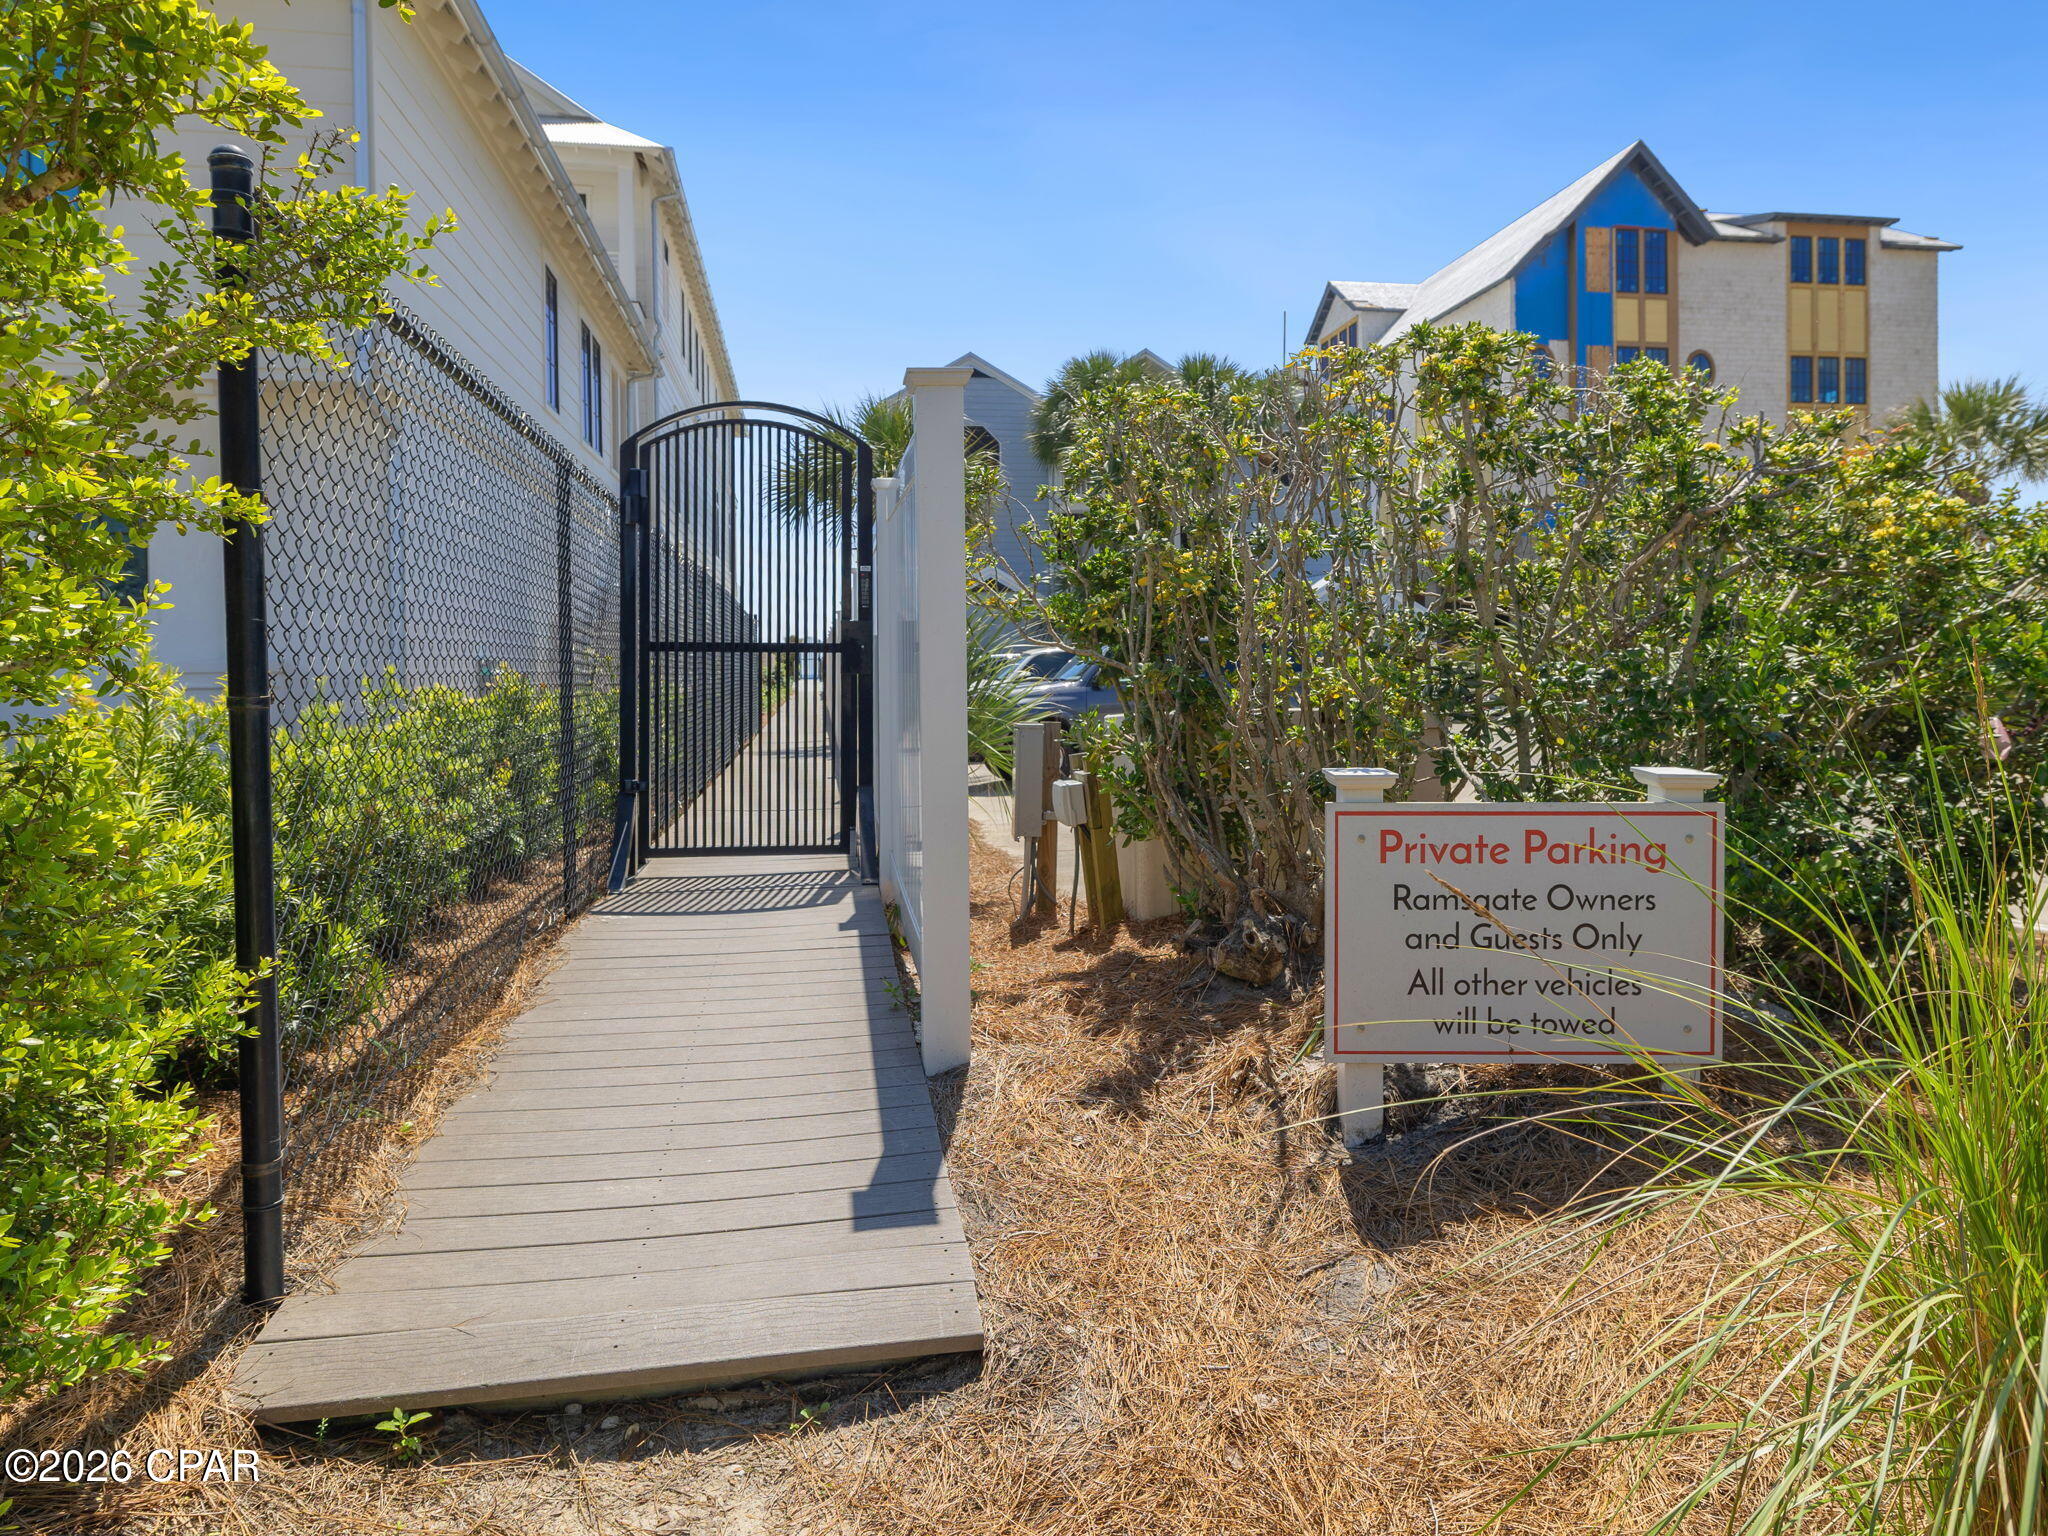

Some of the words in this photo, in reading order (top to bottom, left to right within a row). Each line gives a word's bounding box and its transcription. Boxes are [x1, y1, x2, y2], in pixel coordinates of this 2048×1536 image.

[1380, 829, 1511, 864] Private
[1524, 827, 1666, 873] Parking
[1393, 884, 1537, 917] Ramsgate
[1547, 884, 1656, 911] Owners
[1405, 922, 1460, 950] and
[1471, 923, 1562, 950] Guests
[1572, 922, 1642, 957] Only
[1407, 968, 1443, 996] All
[1454, 969, 1528, 996] other
[1534, 968, 1642, 996] vehicles
[1434, 1007, 1477, 1035] will
[1488, 1007, 1520, 1035] be
[1530, 1007, 1615, 1035] towed
